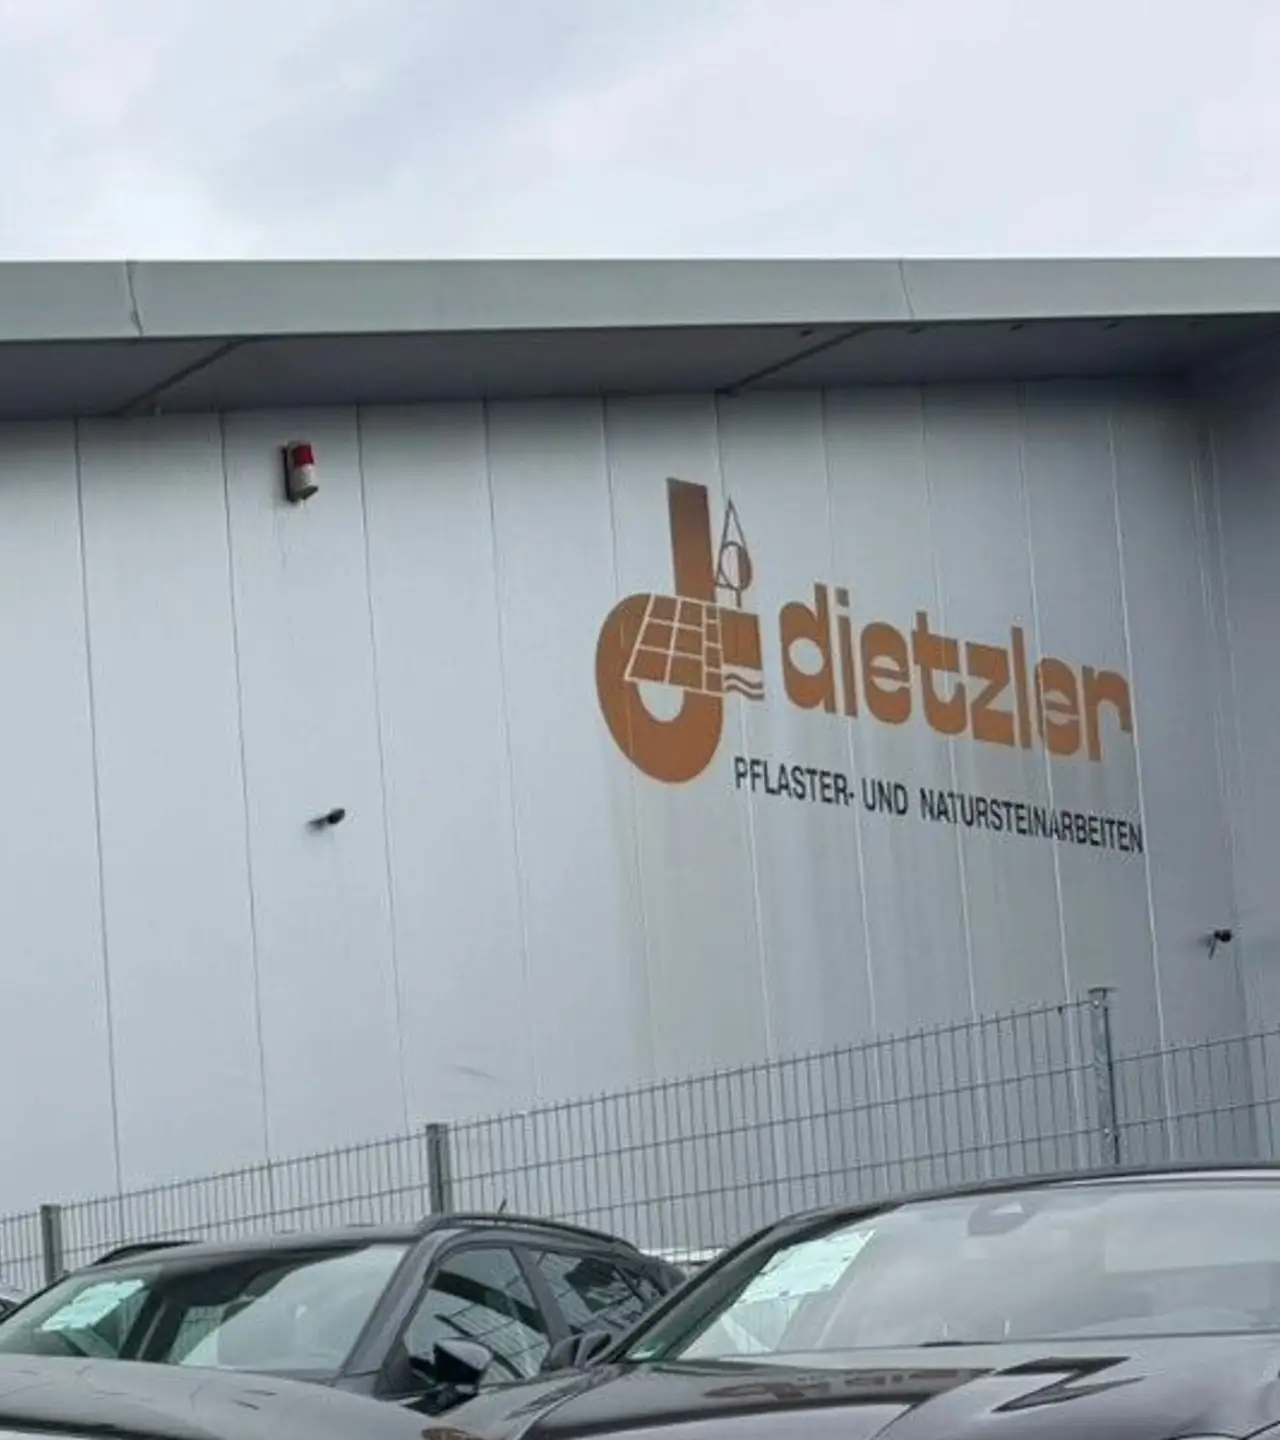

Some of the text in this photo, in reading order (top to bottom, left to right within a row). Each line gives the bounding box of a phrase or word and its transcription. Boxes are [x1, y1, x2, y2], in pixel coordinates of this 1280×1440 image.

[778, 582, 1135, 763] dietzler
[733, 755, 1144, 854] PFLASTER- UND NATURSTEINARBEITEN
